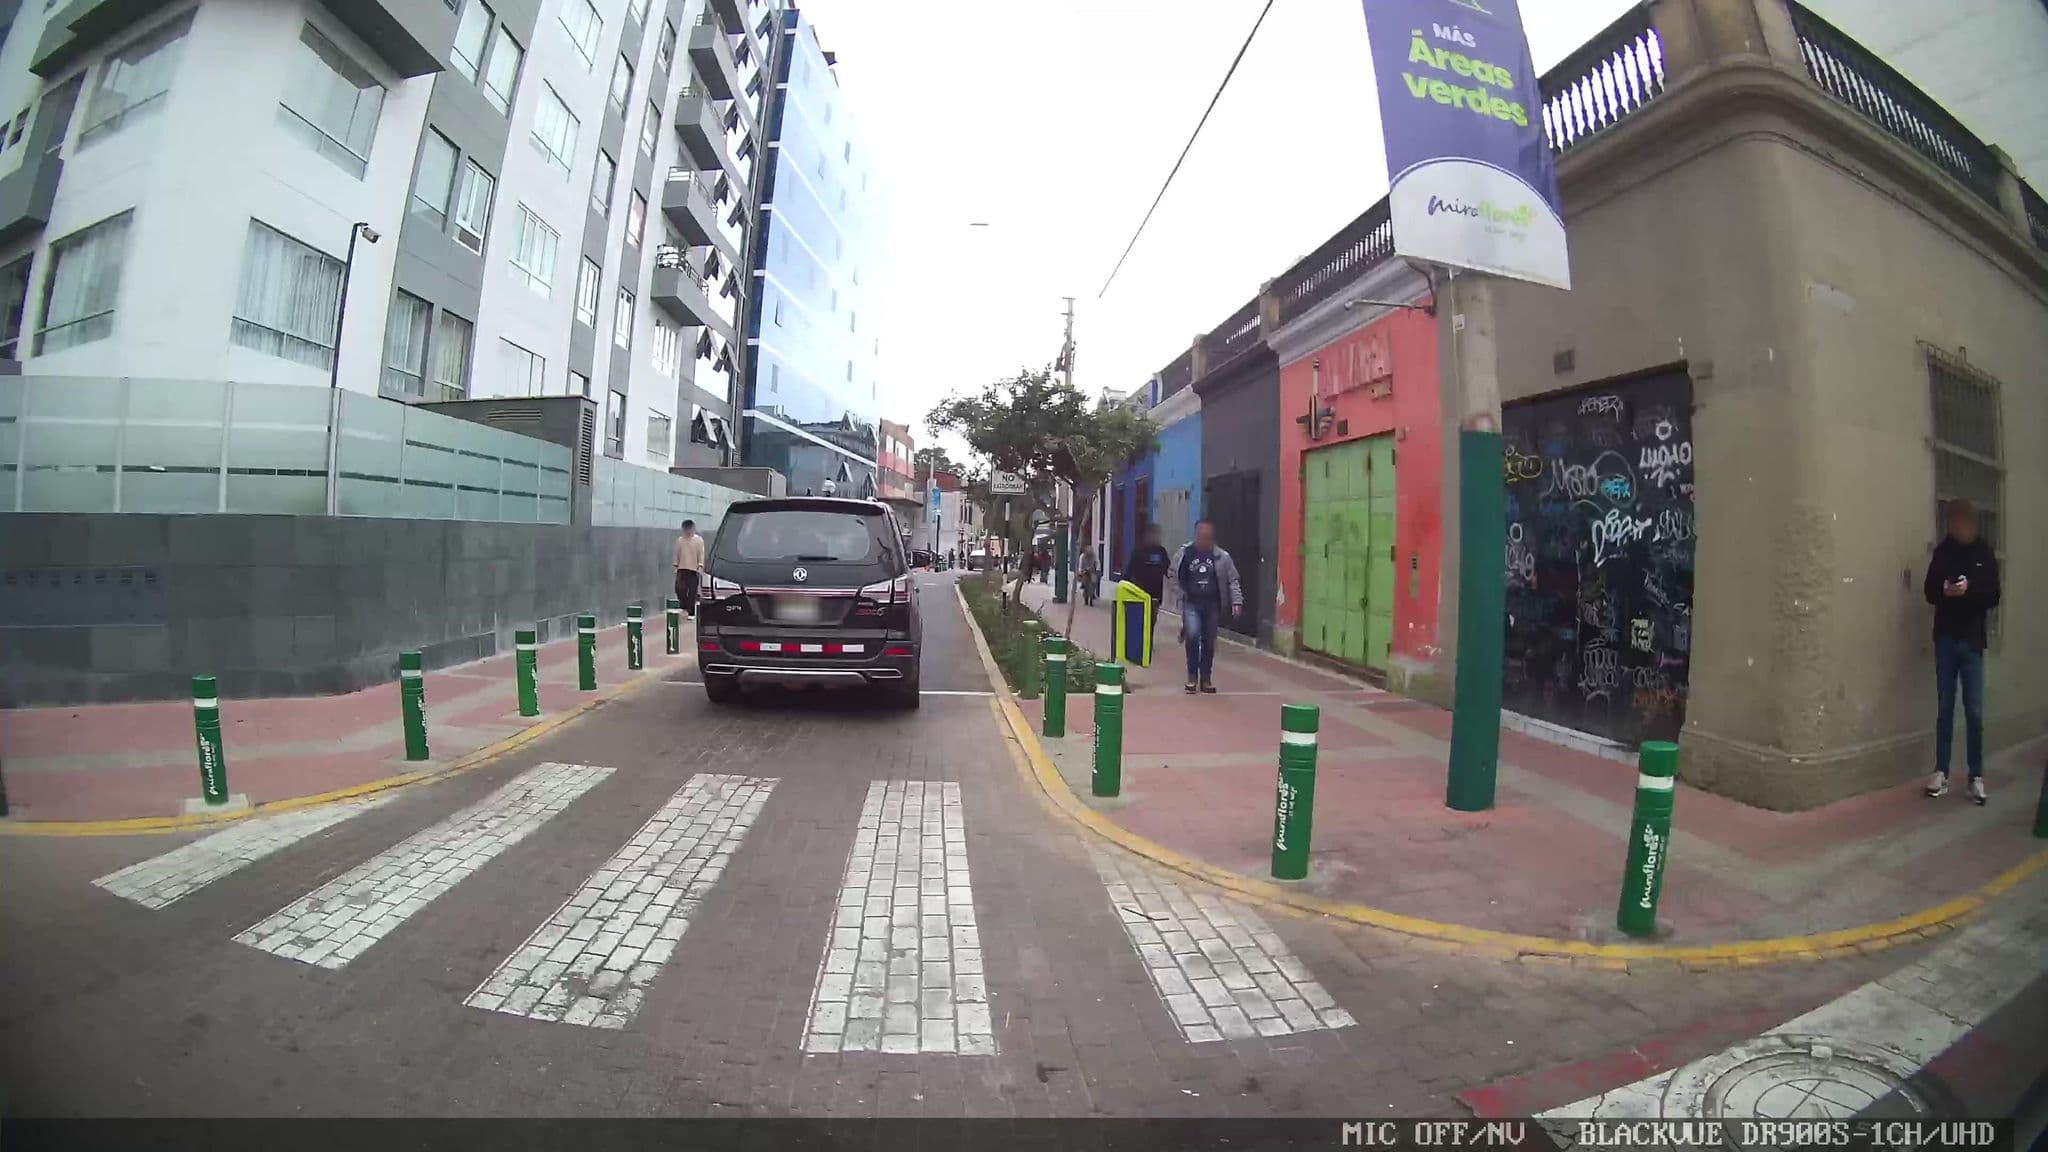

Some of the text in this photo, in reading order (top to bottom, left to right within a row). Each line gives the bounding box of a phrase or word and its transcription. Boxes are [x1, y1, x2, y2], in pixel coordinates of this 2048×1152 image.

[1407, 29, 1515, 90] Áreas
[1432, 22, 1477, 48] MÁS
[1402, 72, 1529, 127] verdes
